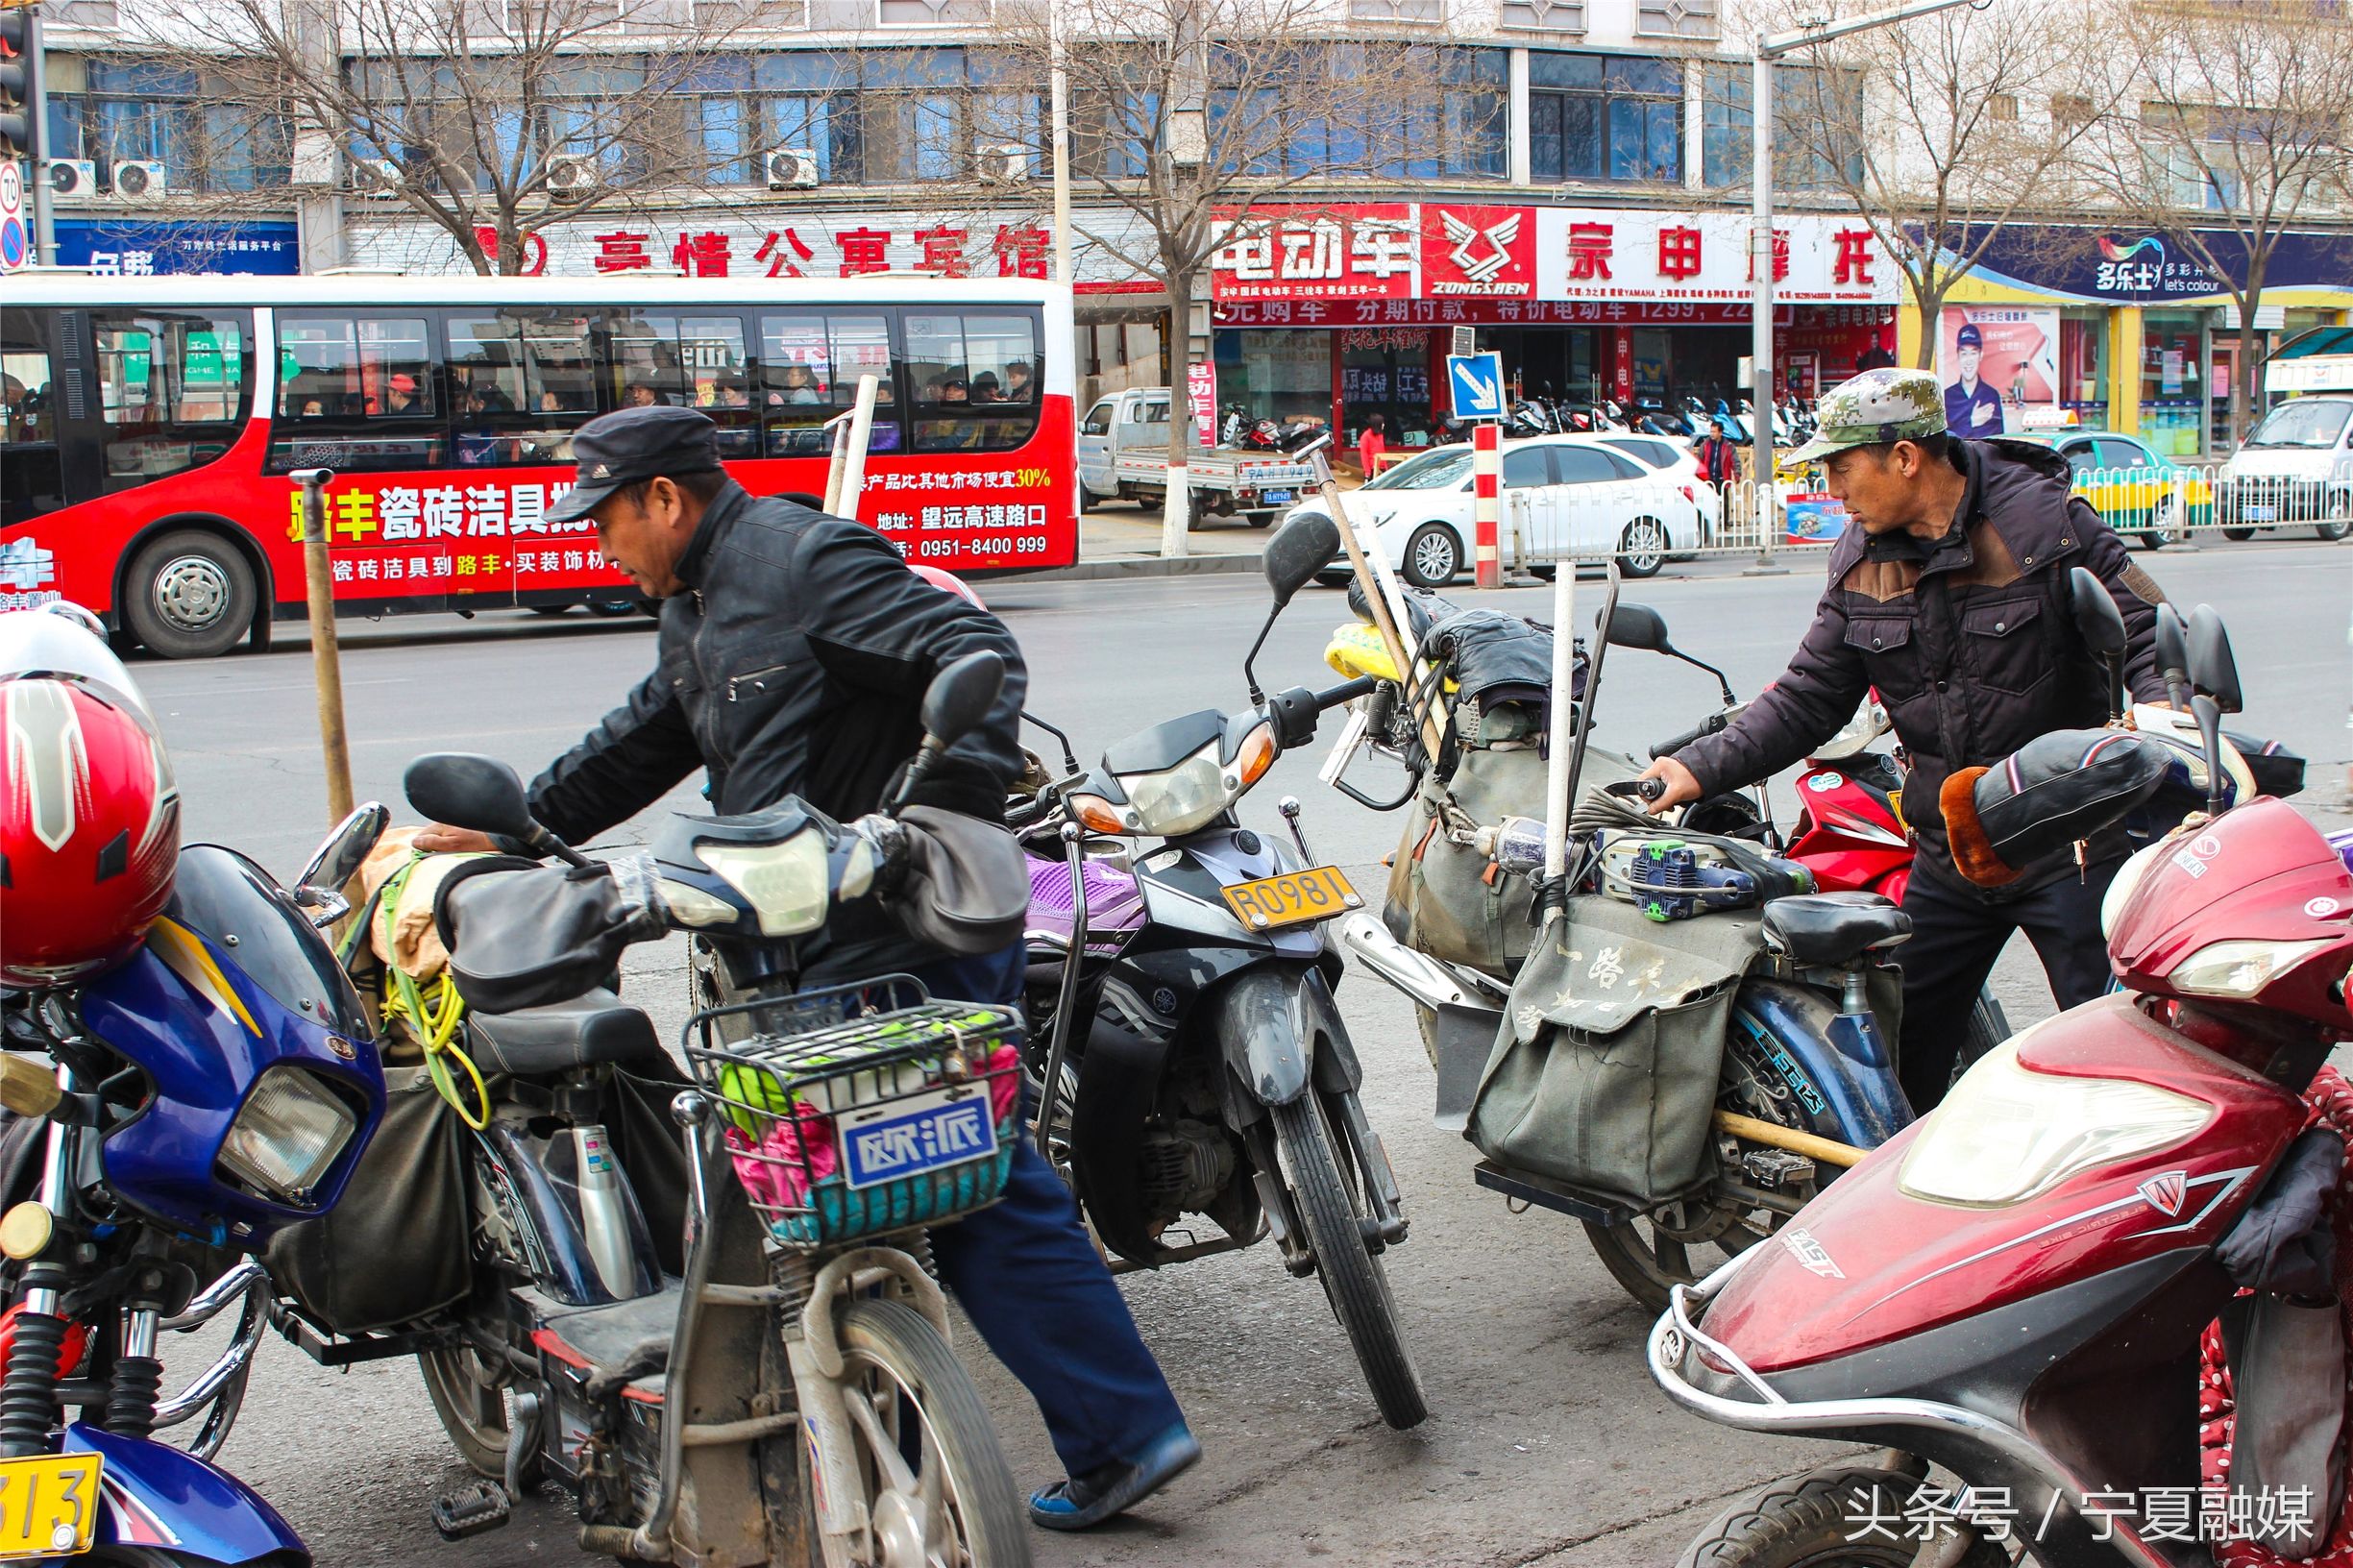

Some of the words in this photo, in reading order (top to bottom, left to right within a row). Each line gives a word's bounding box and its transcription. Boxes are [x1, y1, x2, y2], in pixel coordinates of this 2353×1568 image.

[4, 179, 17, 202] 70
[1211, 217, 1413, 280] 电动车
[1567, 222, 1875, 284] 宗申摩托
[1262, 286, 1291, 296] 电动车
[1431, 281, 1530, 296] ZONGSHEN
[2096, 261, 2154, 291] 多乐士
[2164, 279, 2186, 292] let's
[2187, 279, 2219, 292] colour
[920, 504, 1046, 530] 望远高速路口
[919, 532, 1012, 557] 0951-8400
[1017, 527, 1046, 553] 999
[1231, 870, 1346, 919] B0981
[856, 1107, 982, 1174] 欧派
[1786, 1228, 1846, 1280] FAST
